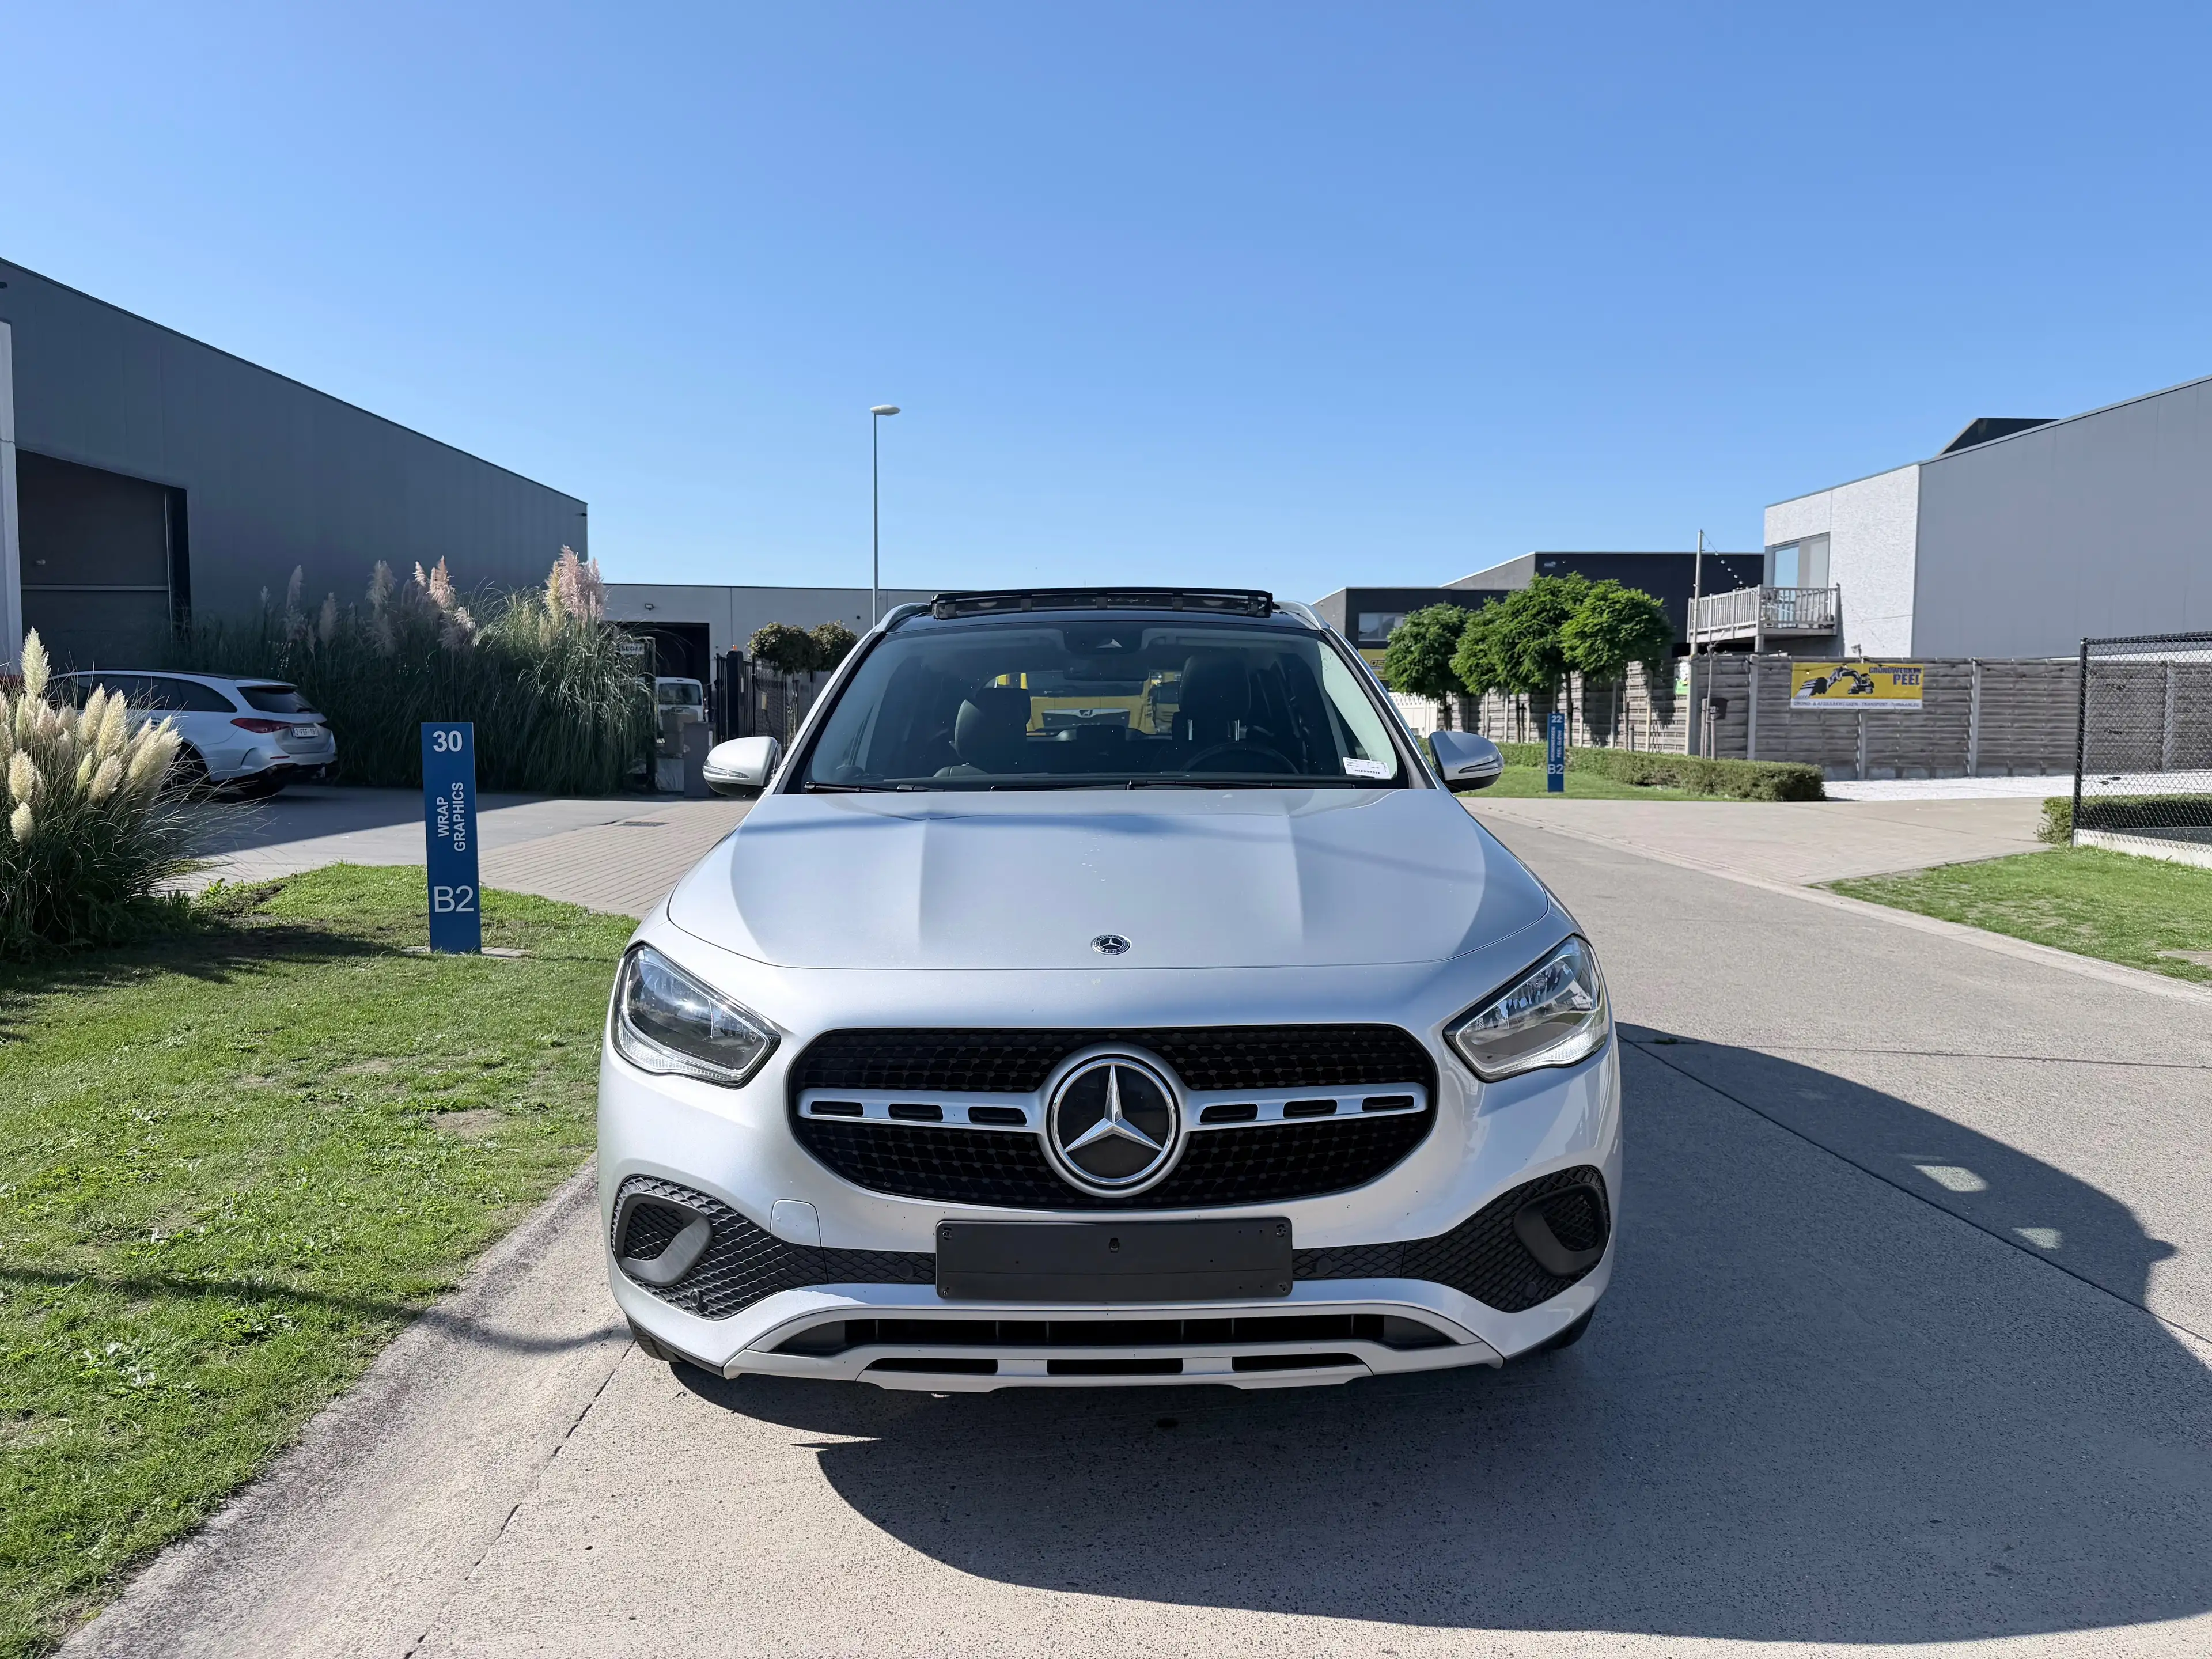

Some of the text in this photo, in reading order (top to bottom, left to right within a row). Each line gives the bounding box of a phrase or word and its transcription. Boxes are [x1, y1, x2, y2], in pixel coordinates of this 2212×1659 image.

[1893, 674, 1920, 685] PEEL
[1551, 715, 1562, 723] 22
[433, 730, 463, 752] 30
[1548, 764, 1563, 775] B2
[437, 797, 449, 838] WRAP
[452, 782, 466, 851] GRAPHICS
[434, 885, 474, 912] B2
